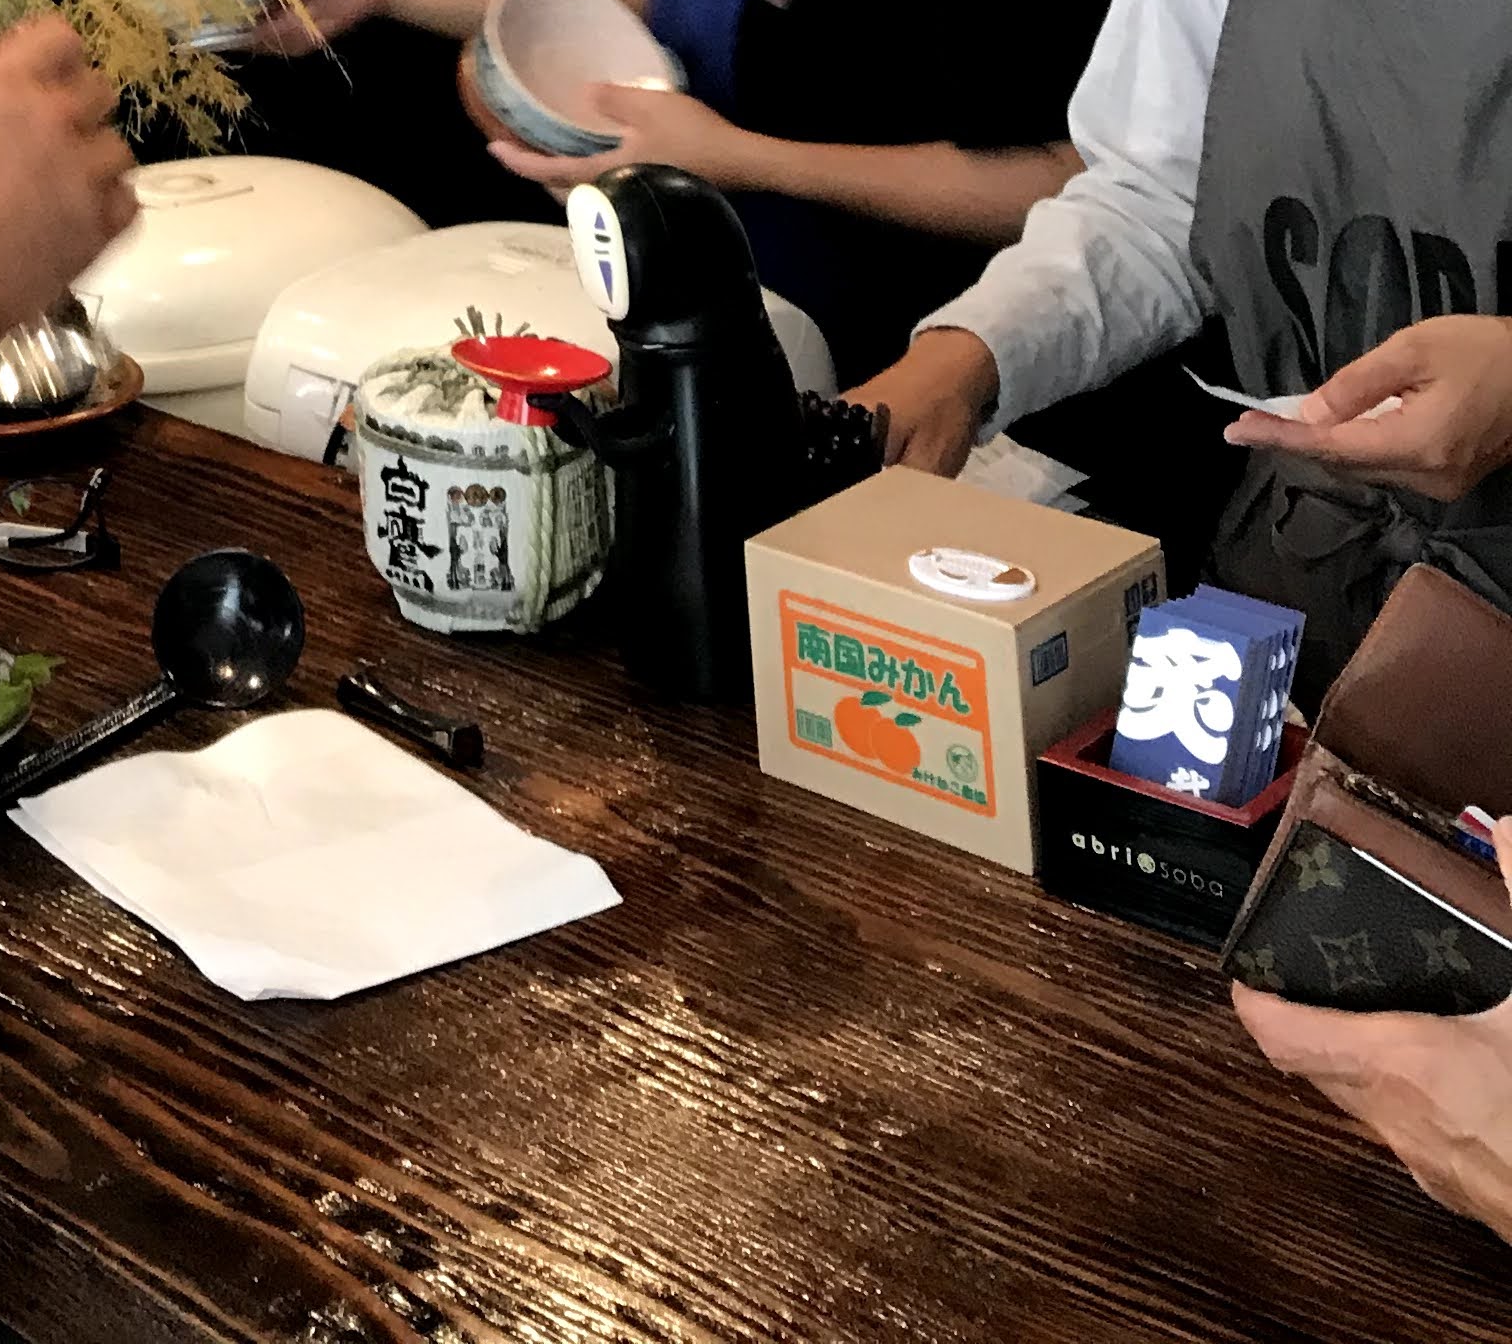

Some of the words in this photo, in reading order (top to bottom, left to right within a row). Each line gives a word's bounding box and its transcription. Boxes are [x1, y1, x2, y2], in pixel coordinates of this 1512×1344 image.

[795, 621, 972, 716] 南国みかん
[1071, 831, 1134, 866] abri
[1158, 860, 1224, 899] soba
